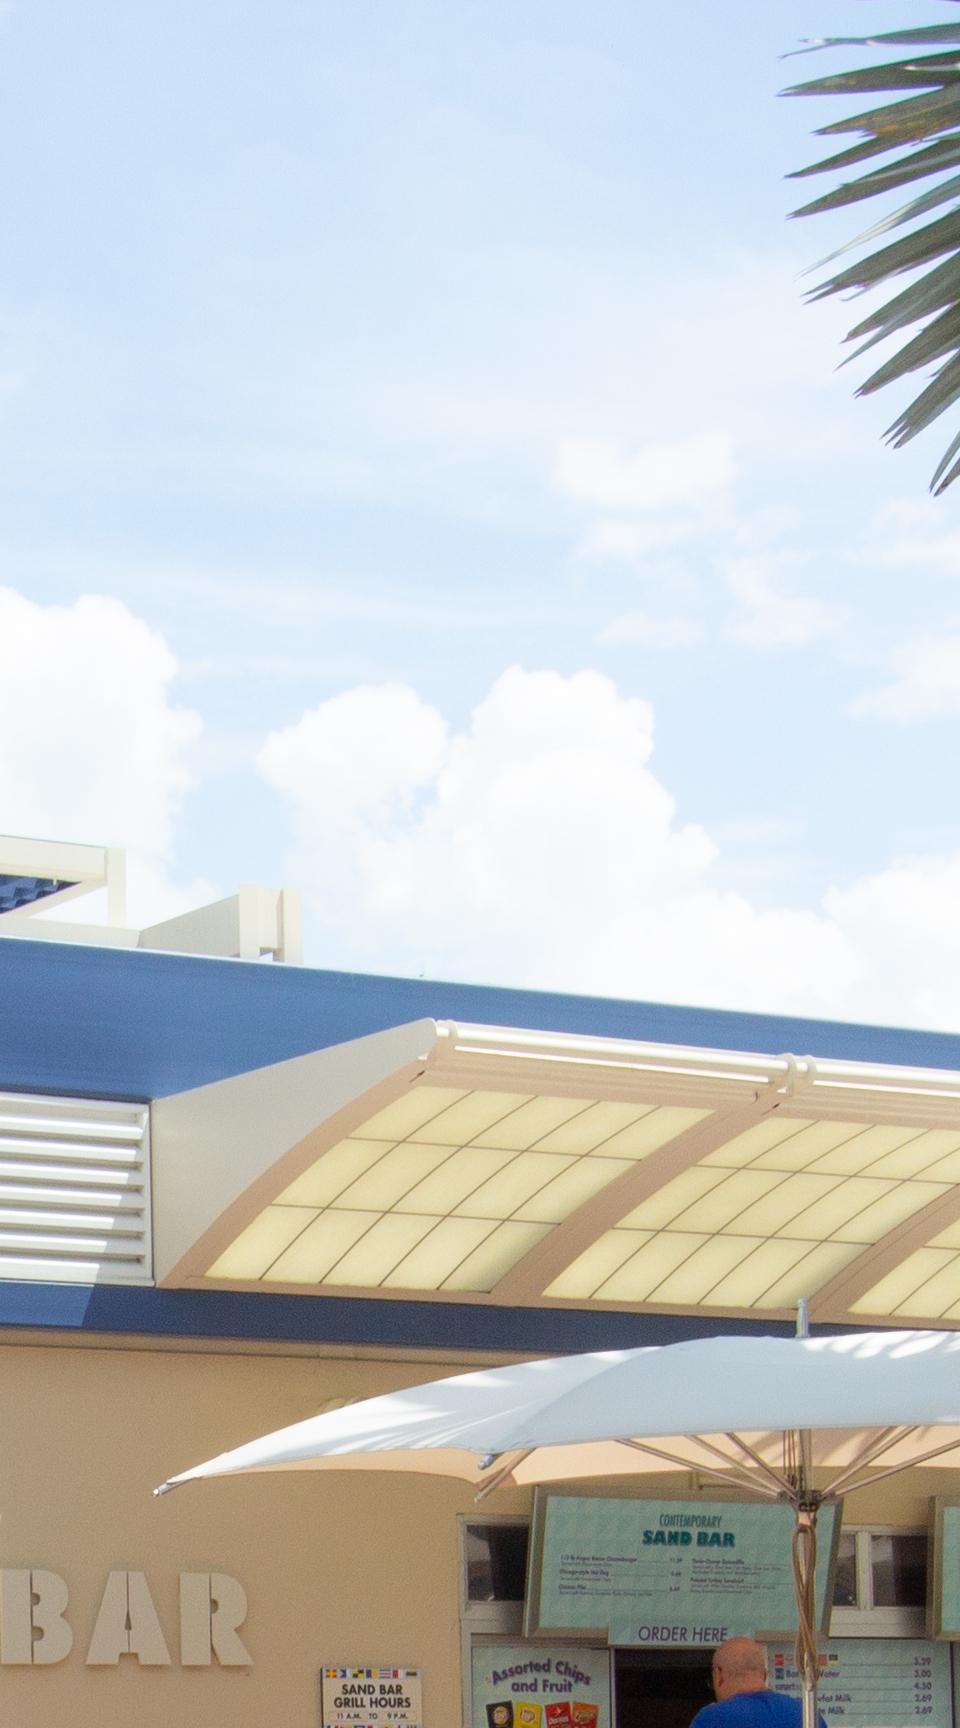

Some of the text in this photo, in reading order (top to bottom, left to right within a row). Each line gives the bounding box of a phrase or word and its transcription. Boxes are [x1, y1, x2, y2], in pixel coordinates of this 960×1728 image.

[659, 1513, 722, 1528] CONTEMPORARY
[642, 1529, 735, 1547] SAND BAR
[0, 1568, 254, 1666] BAR
[638, 1626, 728, 1642] ORDER HERE
[491, 1658, 592, 1686] Assorted Chips
[342, 1684, 403, 1695] SAND BAR
[511, 1678, 573, 1692] and Fruit
[334, 1697, 411, 1708] GRILL HOURS
